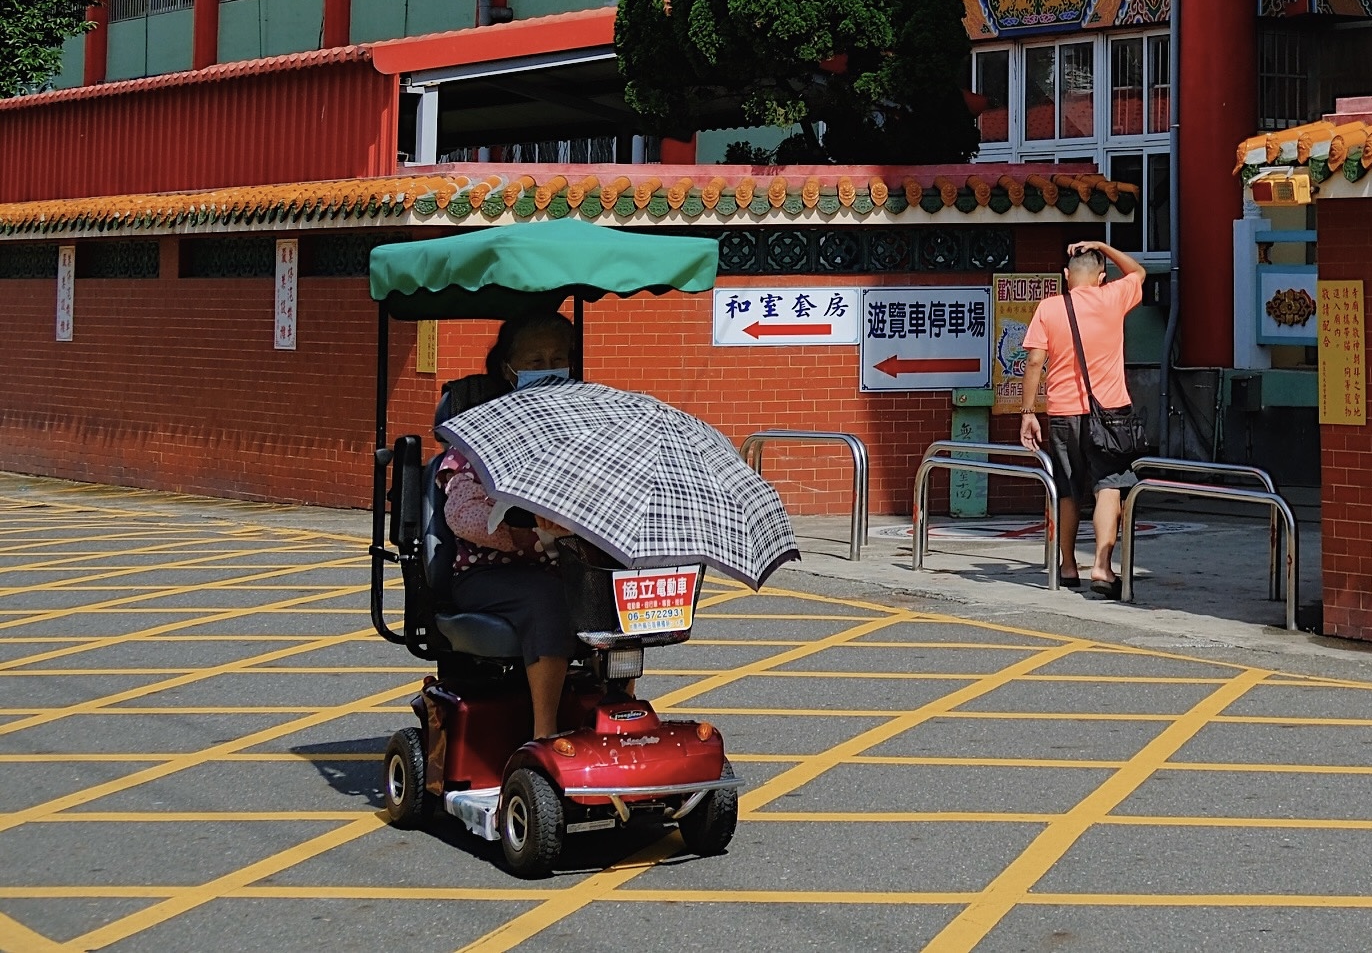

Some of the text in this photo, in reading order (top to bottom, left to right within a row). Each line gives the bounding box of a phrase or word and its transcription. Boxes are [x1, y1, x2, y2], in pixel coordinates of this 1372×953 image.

[997, 278, 1058, 302] 歡迎蒞臨
[724, 292, 850, 319] 和室套房
[867, 300, 986, 340] 遊覽車停車場
[621, 577, 688, 601] 協立電動車
[627, 608, 684, 621] 06-5722931
